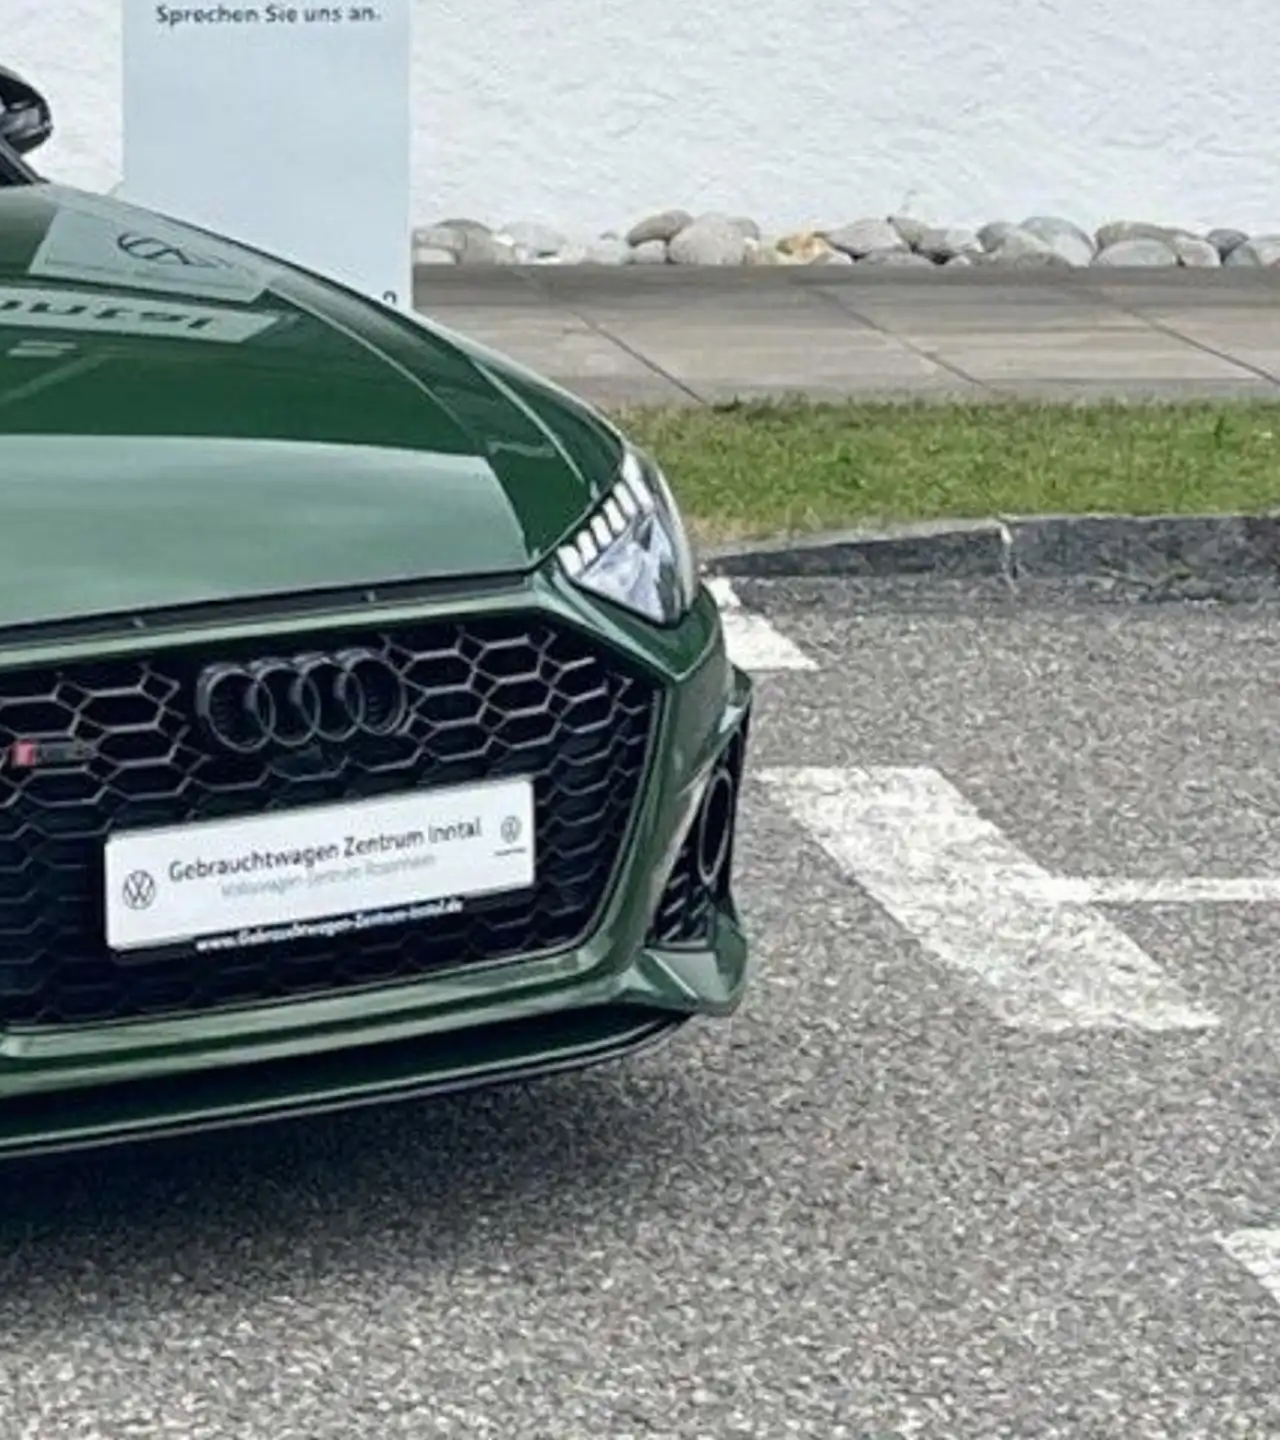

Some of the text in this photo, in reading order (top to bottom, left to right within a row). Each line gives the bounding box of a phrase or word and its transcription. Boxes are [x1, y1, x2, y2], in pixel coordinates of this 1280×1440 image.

[155, 3, 381, 28] Sprechen Sie uns an.
[166, 841, 341, 883] Gebrauchtwagen
[343, 832, 424, 857] Zentrum
[427, 816, 482, 844] Inntal
